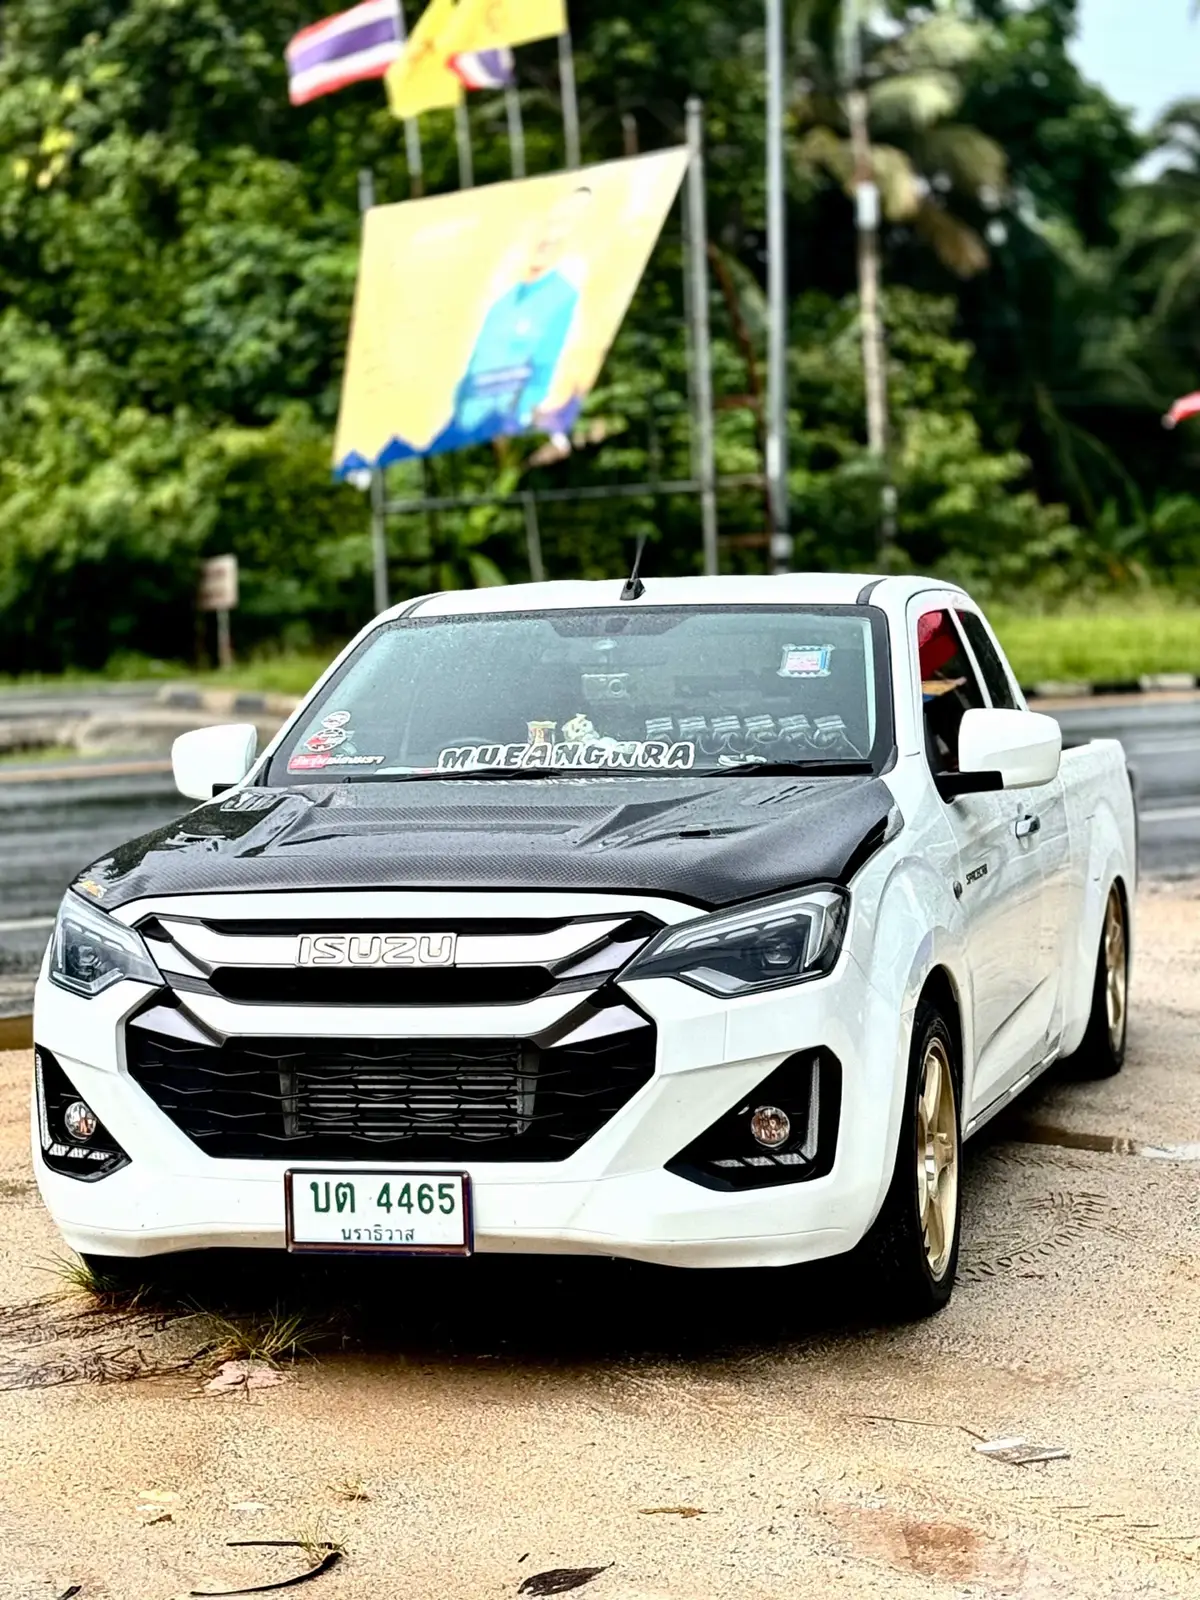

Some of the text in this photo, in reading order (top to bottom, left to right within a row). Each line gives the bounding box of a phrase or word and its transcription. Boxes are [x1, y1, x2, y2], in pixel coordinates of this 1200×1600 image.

[298, 936, 453, 964] ISUZU
[310, 1181, 455, 1214] บต 4465
[341, 1224, 415, 1241] นราธิวาส
